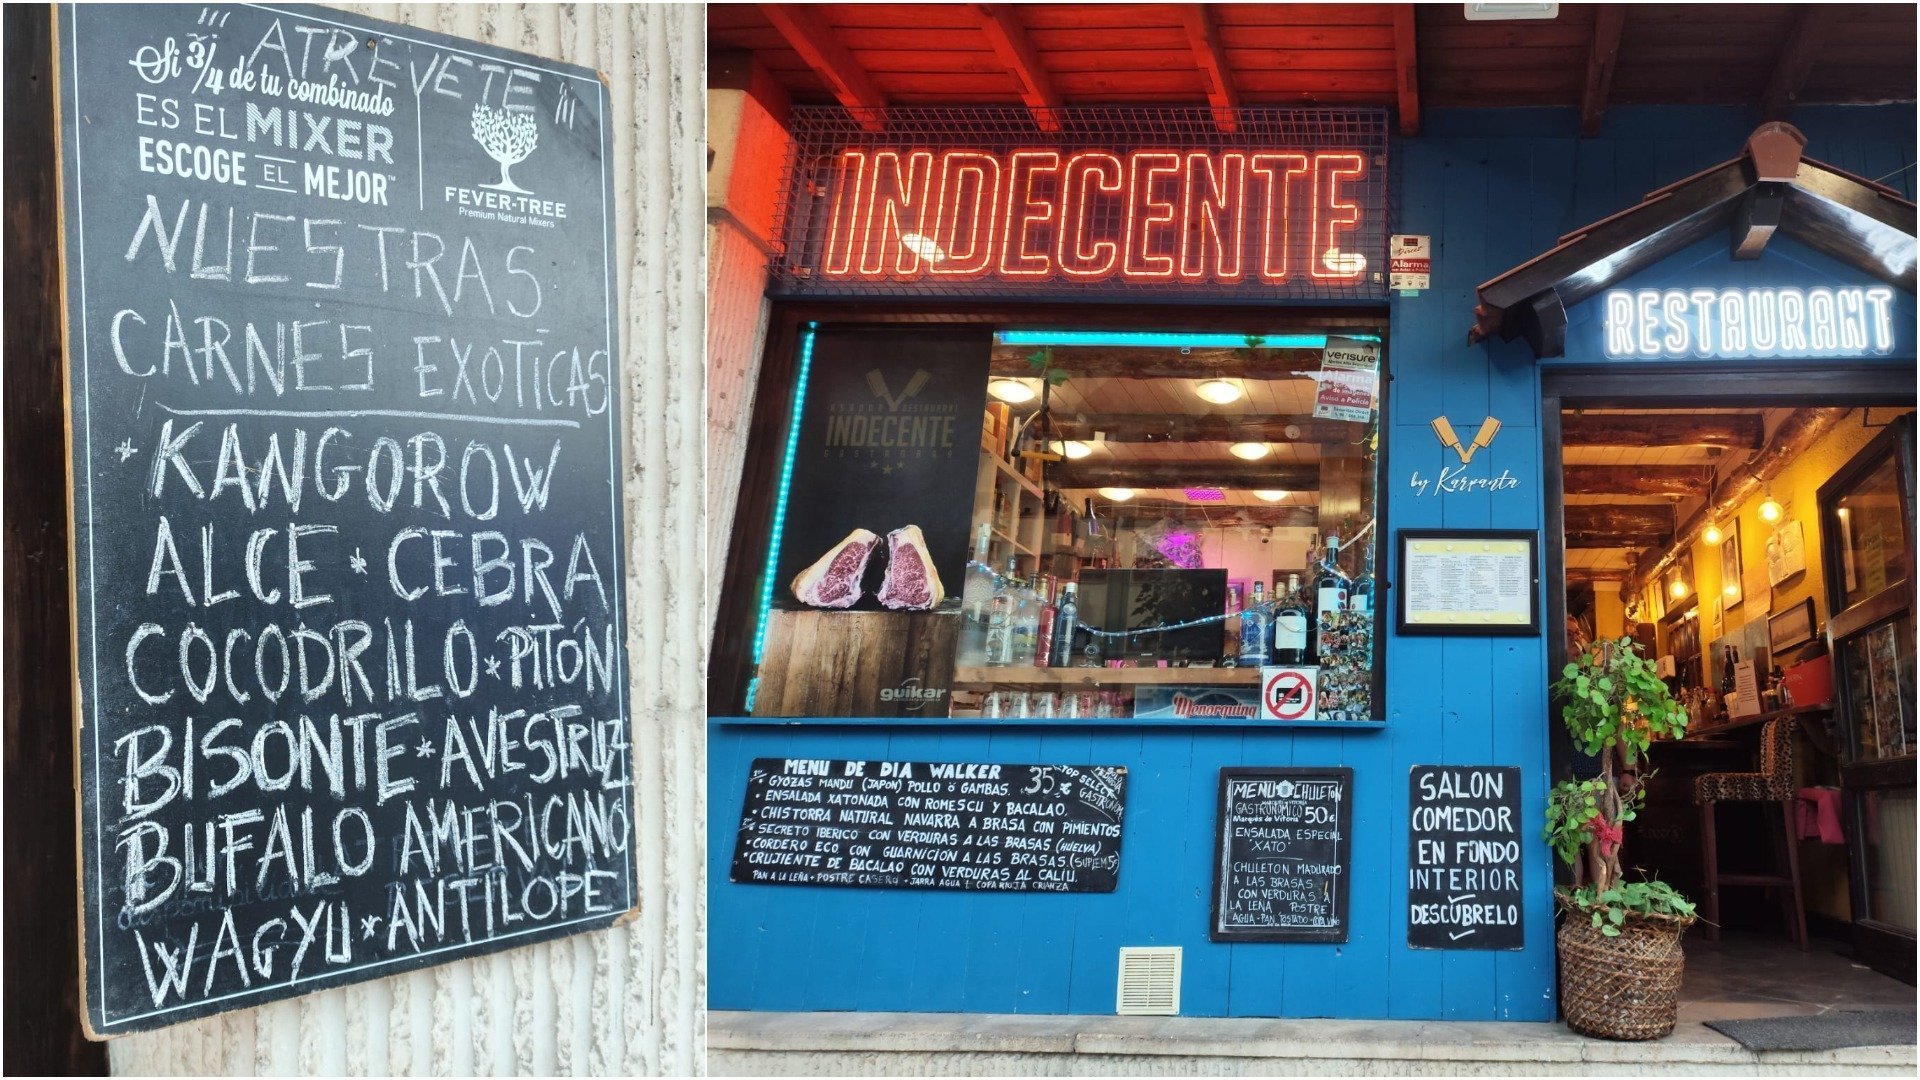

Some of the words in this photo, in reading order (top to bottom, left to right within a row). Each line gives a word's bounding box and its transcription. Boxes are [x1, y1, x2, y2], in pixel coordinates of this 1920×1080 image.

[129, 36, 182, 83] Si
[229, 55, 257, 91] de
[261, 64, 283, 97] tu
[287, 74, 395, 117] combinado
[246, 17, 542, 113] ATREVETE
[136, 91, 181, 130] ES
[194, 102, 238, 140] EL
[246, 101, 395, 166] MIXER
[139, 136, 247, 187] ESCOGE
[263, 164, 289, 185] EL
[445, 186, 567, 219] FEVER-TREE
[825, 151, 1363, 277] INDECENTE
[458, 206, 496, 221] Premium
[497, 211, 527, 225] Natural
[528, 214, 555, 229] Mixers
[125, 194, 542, 318] NUESTRAS
[1391, 259, 1430, 268] Alarma
[1606, 288, 1893, 354] RESTAURANT
[110, 299, 374, 397] CARNES
[1327, 351, 1376, 363] verisure
[1320, 370, 1374, 384] Alarma
[1319, 394, 1339, 402] Aviso
[825, 416, 956, 447] INDECENTE
[152, 418, 562, 520] KANGOROW
[1410, 471, 1430, 496] by
[1434, 465, 1521, 497] Karpanta
[146, 516, 339, 608] ALCE
[387, 526, 610, 623] CEBRA
[126, 616, 480, 706] COCODRILO
[880, 686, 946, 701] guikar
[114, 713, 420, 823] BISONTE
[440, 704, 634, 792] AVESTRUZ
[784, 759, 830, 777] MENU
[844, 761, 866, 777] DE
[880, 762, 913, 779] DIA
[929, 763, 1001, 780] WALKER
[1061, 765, 1080, 778] TOP
[768, 775, 813, 787] GYOZAS
[819, 778, 853, 790] MANDU
[907, 780, 941, 793] POLLO
[1233, 782, 1276, 799] MENU
[1293, 784, 1342, 802] CHULETON
[1420, 771, 1504, 801] SALON
[765, 790, 821, 804] ENSALADA
[827, 793, 889, 809] XATONADA
[897, 796, 920, 809] CON
[925, 798, 984, 813] ROMESCU
[992, 801, 1001, 814] Y
[761, 806, 831, 821] CHISTORRA
[839, 810, 894, 826] NATURAL
[903, 813, 960, 829] NAVARRA
[968, 816, 977, 829] A
[982, 817, 1026, 832] BRASA
[1033, 821, 1054, 834] CON
[1235, 827, 1291, 840] ENSALADA
[1296, 829, 1343, 840] ESPECIAL
[1412, 806, 1514, 833] COMEDOR
[752, 837, 808, 851] CORDERO
[849, 845, 871, 857] CON
[962, 851, 970, 863] A
[975, 852, 1001, 865] LAS
[758, 823, 810, 836] SECRETO
[816, 827, 858, 840] IBERICO
[868, 829, 891, 841] CON
[897, 830, 958, 846] VERDURAS
[962, 834, 972, 846] A
[976, 835, 999, 847] LAS
[1004, 836, 1052, 851] BRASAS
[115, 805, 376, 915] BUFALO
[400, 790, 632, 878] AMERICANO
[1418, 839, 1446, 865] EN
[1456, 839, 1520, 865] FONDO
[748, 852, 822, 867] CRUJIENTE
[826, 857, 843, 869] DE
[848, 858, 904, 873] BACALAO
[910, 863, 936, 876] CON
[941, 866, 1010, 881] VERDURAS
[1015, 868, 1032, 881] AL
[753, 869, 768, 879] PAN
[770, 871, 776, 880] A
[778, 872, 787, 881] LA
[789, 871, 809, 882] LEÑA
[817, 873, 856, 883] POSTRE
[909, 877, 935, 885] JARRA
[939, 879, 960, 887] AGUA
[976, 880, 996, 889] COPA
[1032, 882, 1069, 891] CRIANZA
[1233, 862, 1290, 875] CHULETON
[1297, 863, 1342, 876] MADURADO
[1409, 868, 1519, 891] INTERIOR
[1233, 875, 1240, 885] A
[1246, 876, 1265, 887] LAS
[1270, 877, 1314, 890] BRASAS
[1238, 888, 1258, 899] CON
[1261, 888, 1316, 902] VERDURAS
[1323, 891, 1331, 903] A
[1229, 900, 1242, 911] LA
[1289, 902, 1328, 915] POSTRE
[132, 900, 352, 1008] WAGYU
[387, 869, 619, 953] ANTILOPE
